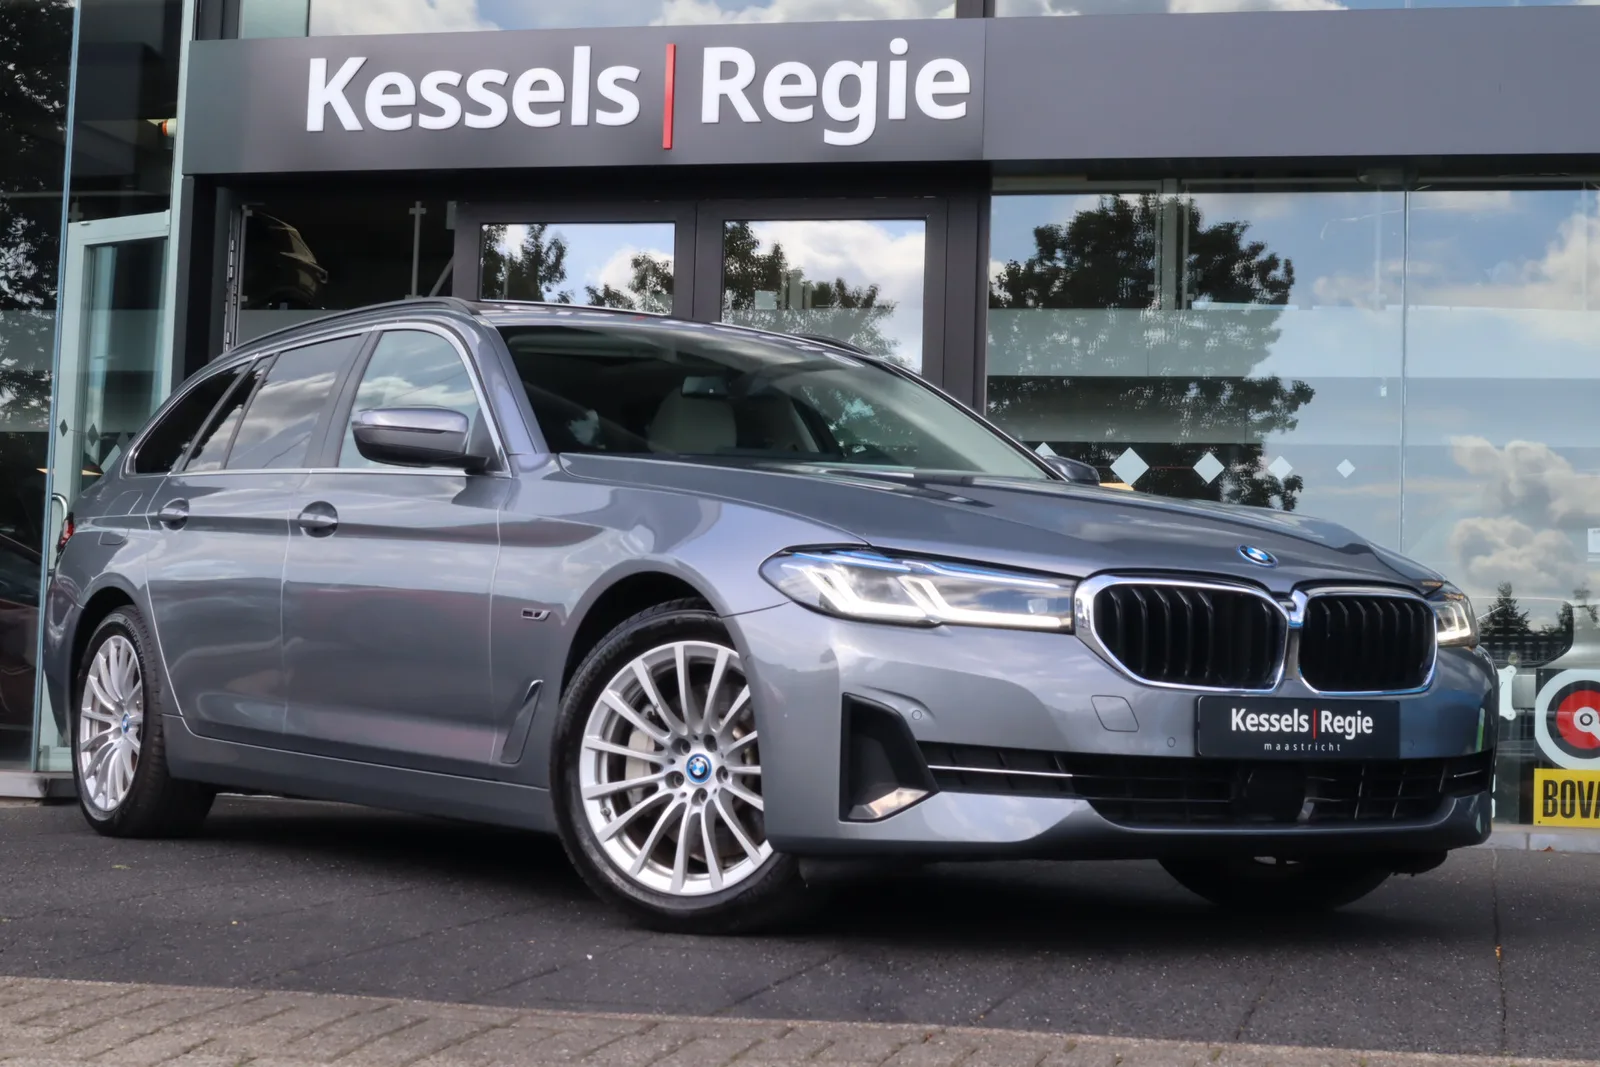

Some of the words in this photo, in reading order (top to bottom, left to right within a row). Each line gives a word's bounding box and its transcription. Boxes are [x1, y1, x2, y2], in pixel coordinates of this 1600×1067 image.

[306, 45, 640, 133] Kessels
[701, 37, 971, 146] Regie
[1231, 708, 1309, 732] Kessels
[1320, 710, 1373, 740] Regie
[1264, 742, 1341, 751] maastricht
